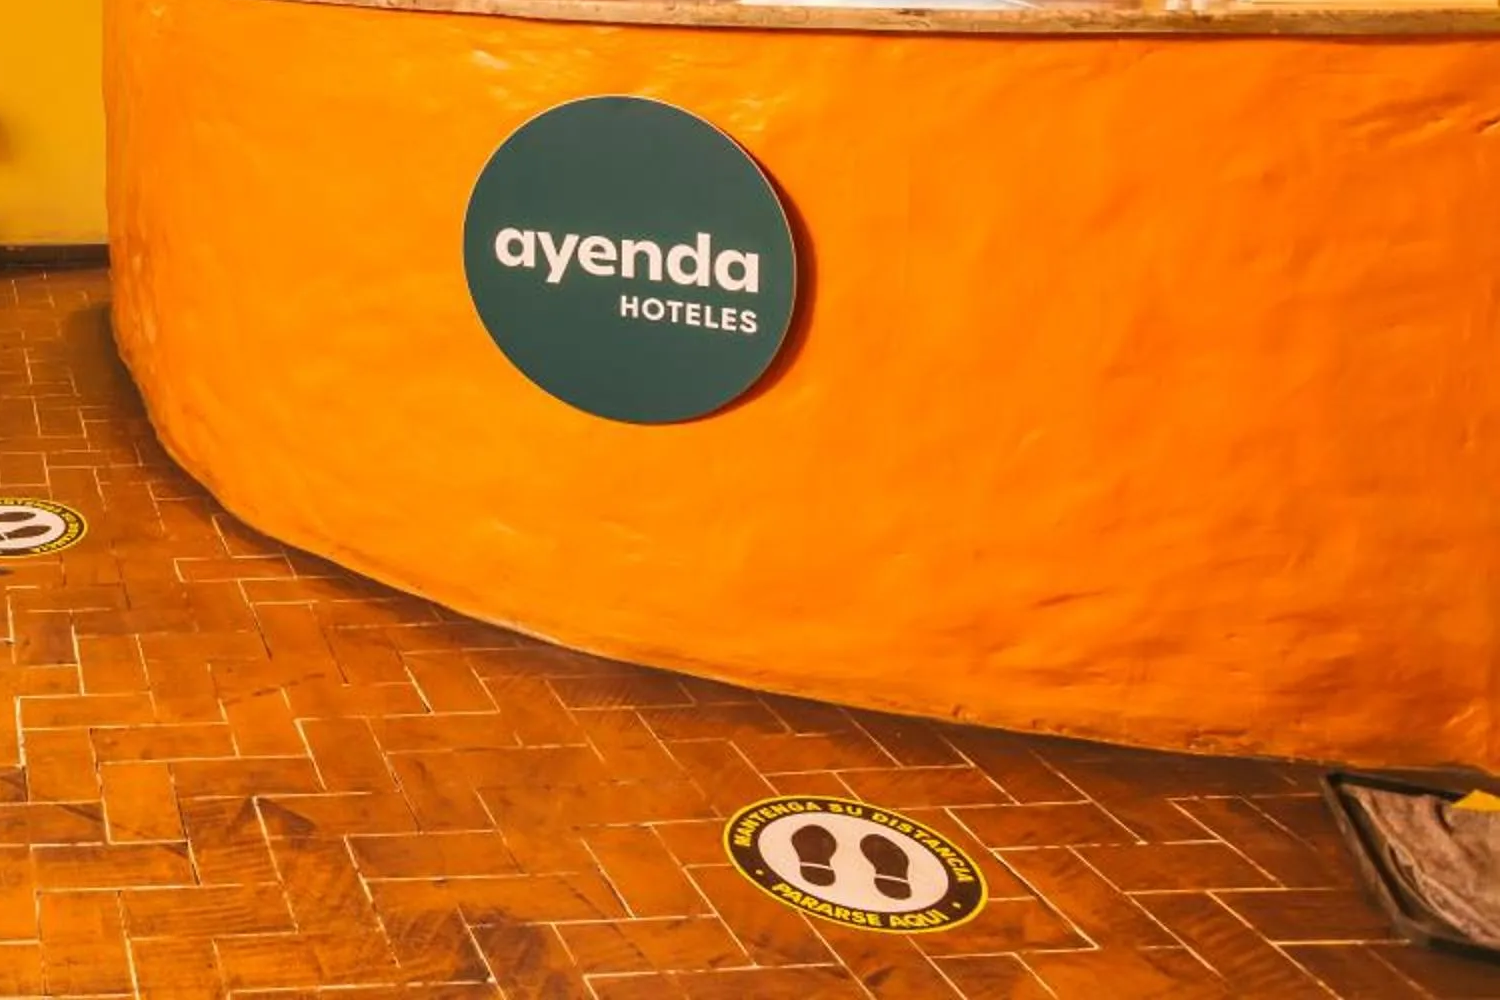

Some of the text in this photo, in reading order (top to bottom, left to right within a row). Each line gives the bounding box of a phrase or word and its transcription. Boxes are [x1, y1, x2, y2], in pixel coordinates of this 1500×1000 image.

[495, 227, 759, 294] ayenda
[620, 296, 758, 333] HOTELES
[734, 800, 975, 883] MANTENGA SU DISTANCIA
[772, 883, 882, 926] PARARSE
